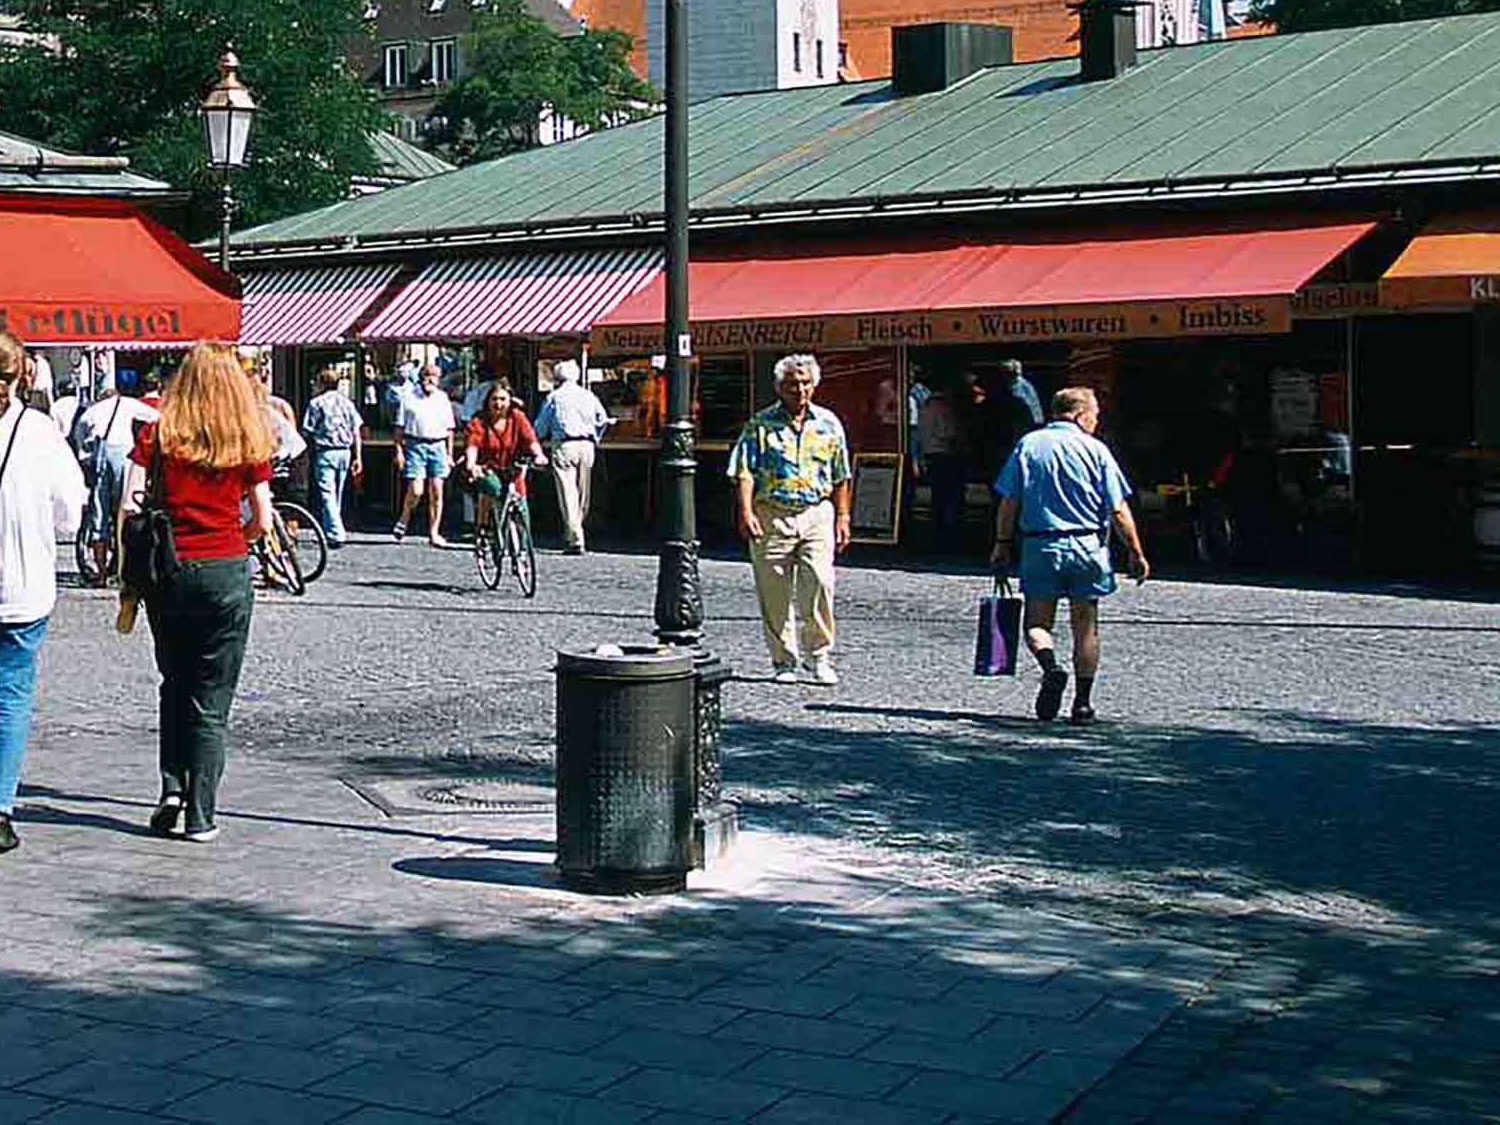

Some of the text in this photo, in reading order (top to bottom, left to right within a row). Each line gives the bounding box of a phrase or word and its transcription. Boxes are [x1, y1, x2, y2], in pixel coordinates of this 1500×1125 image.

[856, 315, 933, 341] Fleisch
[976, 313, 1127, 336] Wurstwaren
[1179, 304, 1267, 329] Imbiss
